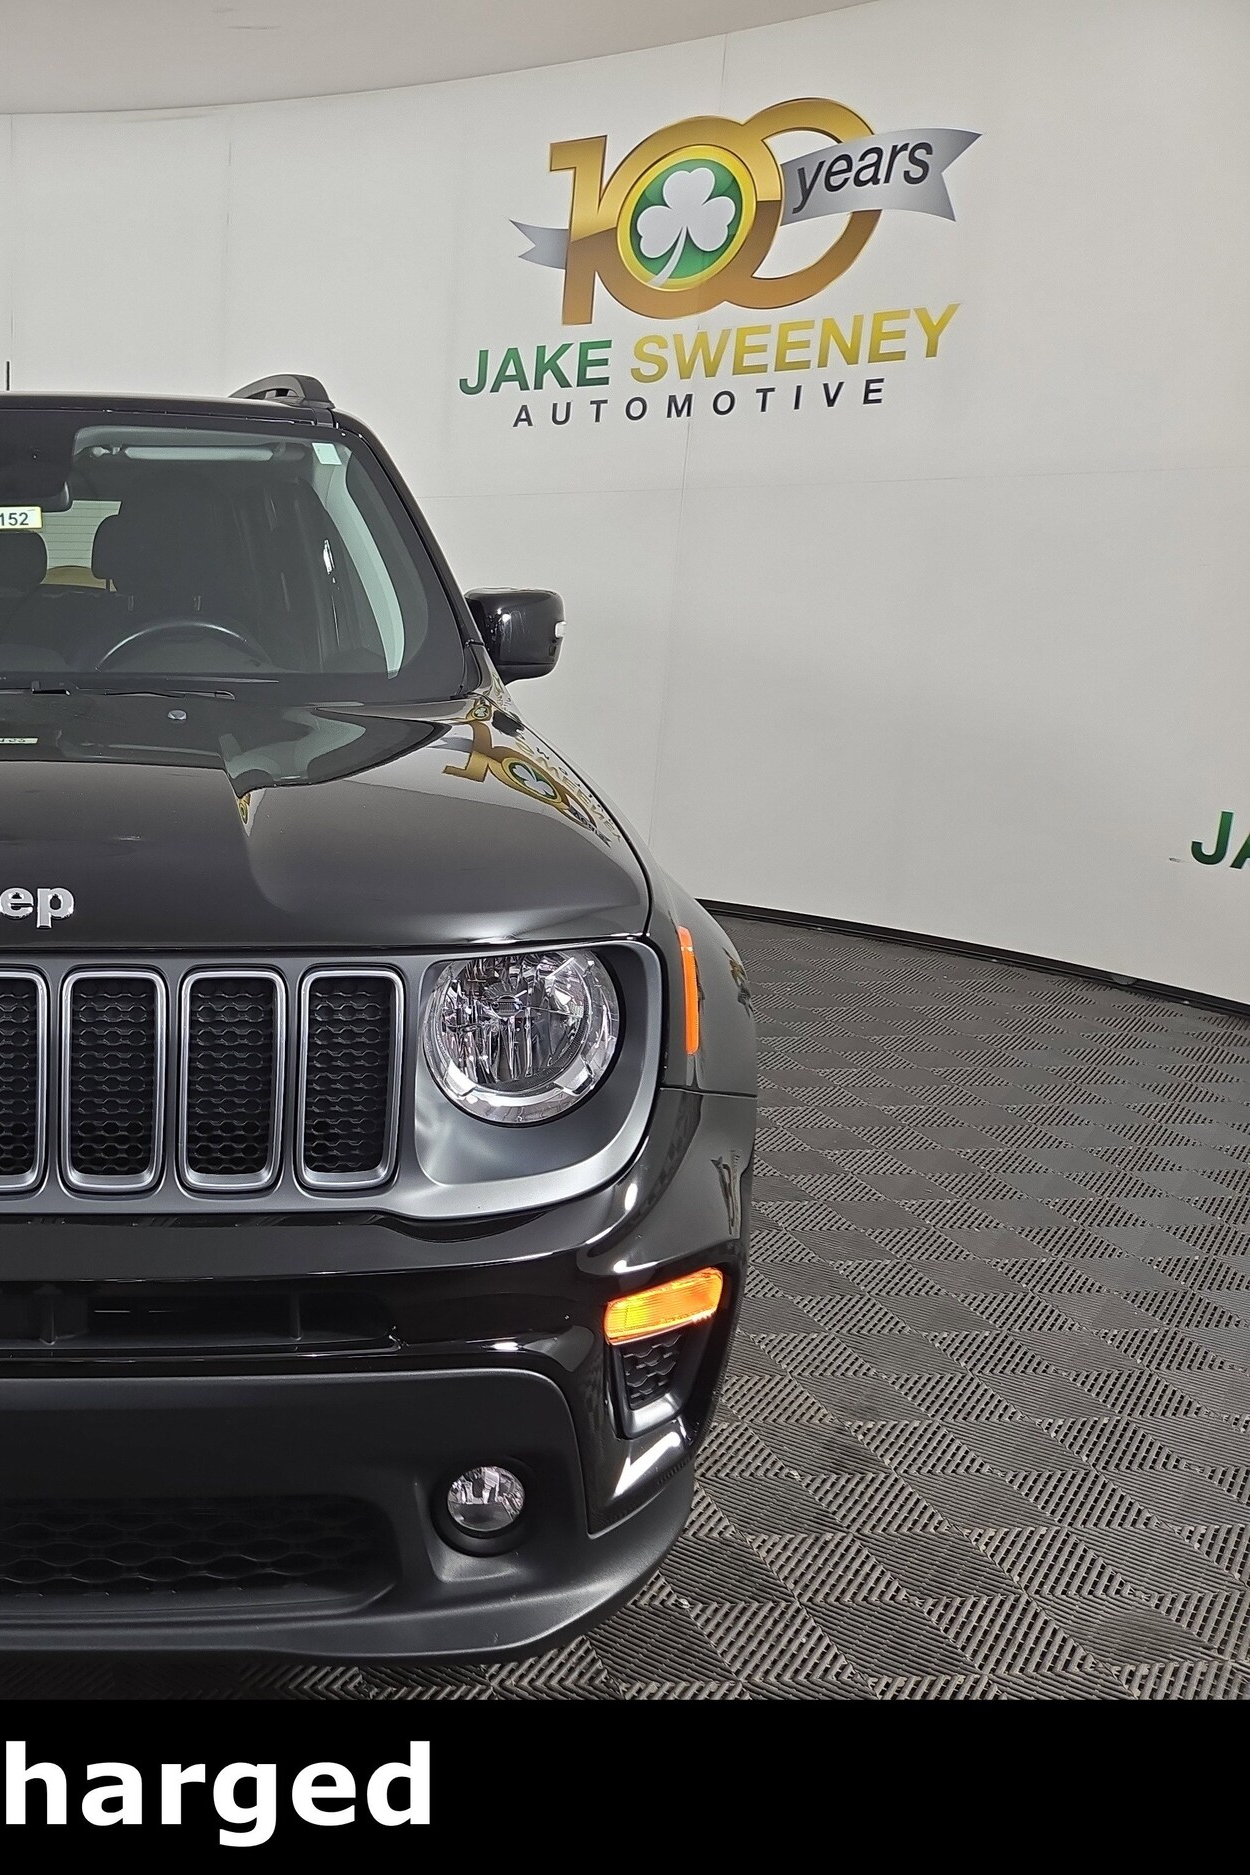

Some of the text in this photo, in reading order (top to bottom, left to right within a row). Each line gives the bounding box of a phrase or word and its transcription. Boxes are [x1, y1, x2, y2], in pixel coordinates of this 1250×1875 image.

[792, 141, 934, 215] years
[459, 303, 961, 396] JAKE SWEENEY
[512, 377, 885, 428] AUTOMOTIVE
